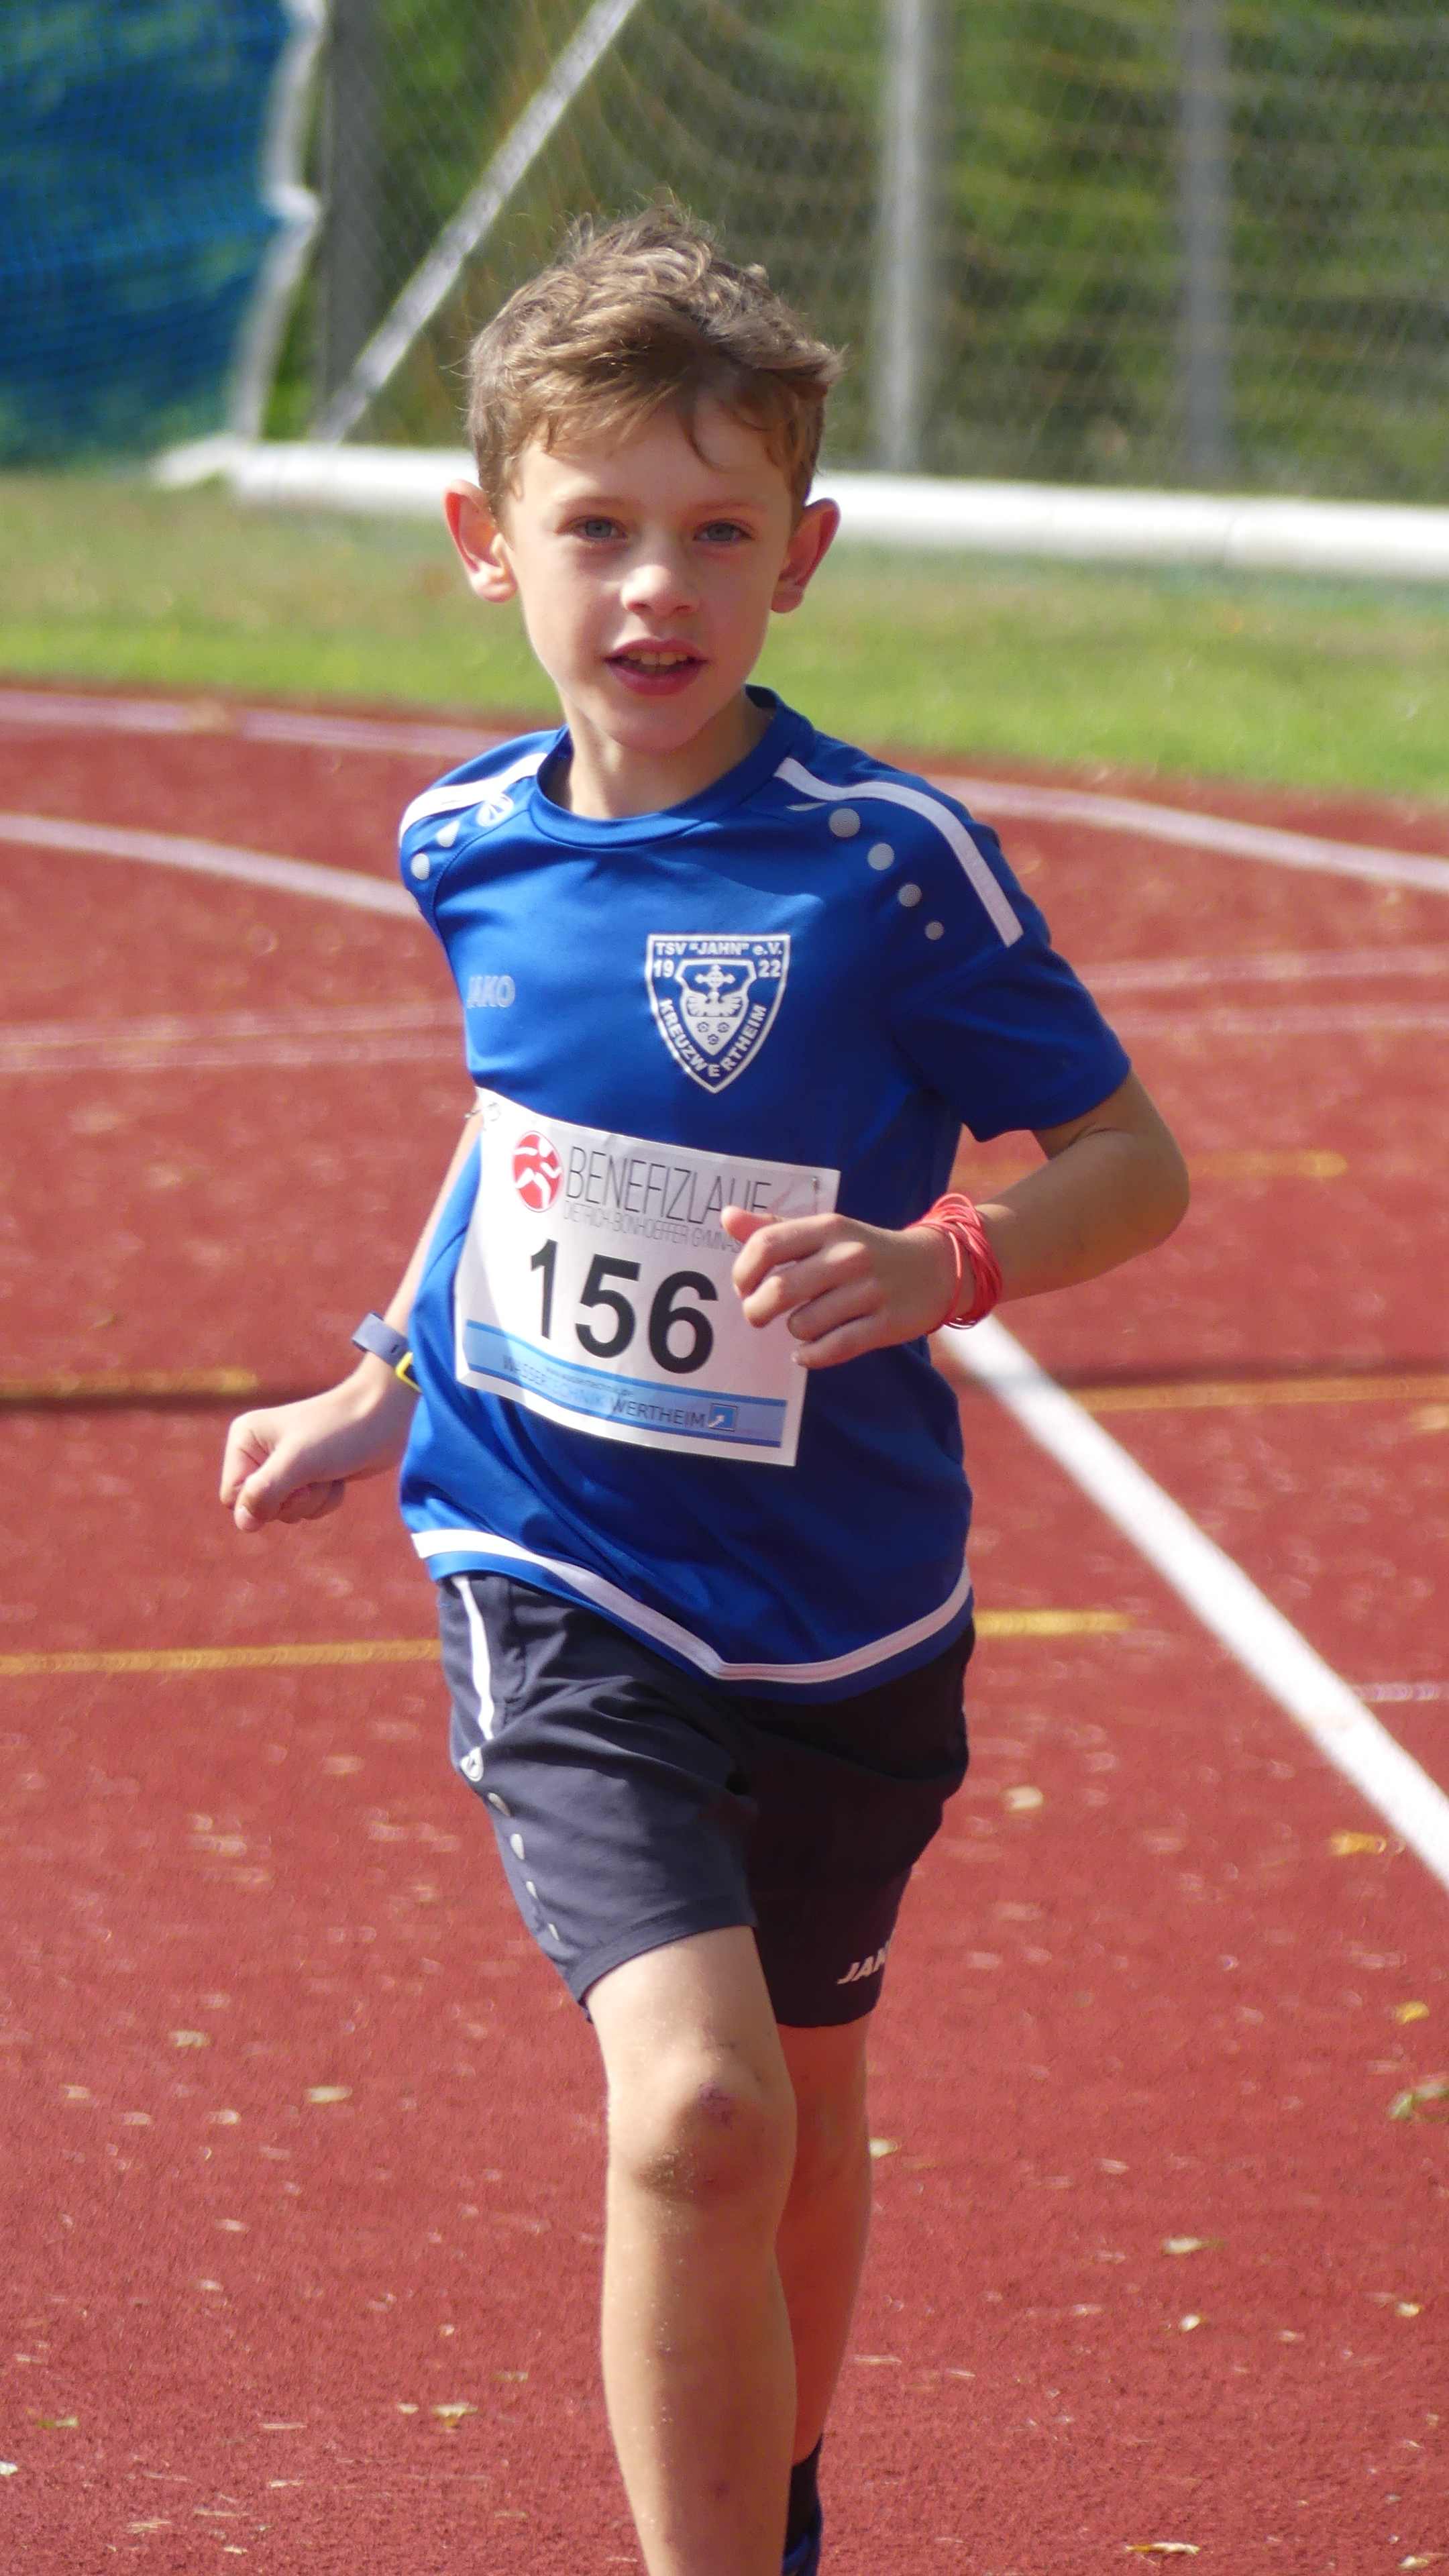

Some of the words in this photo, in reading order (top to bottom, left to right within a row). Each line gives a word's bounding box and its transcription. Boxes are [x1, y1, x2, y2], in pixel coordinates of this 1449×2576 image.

[653, 959, 675, 978] 19
[758, 959, 782, 978] 22
[655, 942, 687, 956] TSV
[688, 942, 750, 956] "JAHN"
[752, 942, 784, 956] e.V.
[658, 998, 767, 1077] KREUZWERTHEIM
[530, 1238, 719, 1375] 156
[610, 1397, 706, 1428] WERTHEIM
[836, 1935, 892, 1984] JAK
